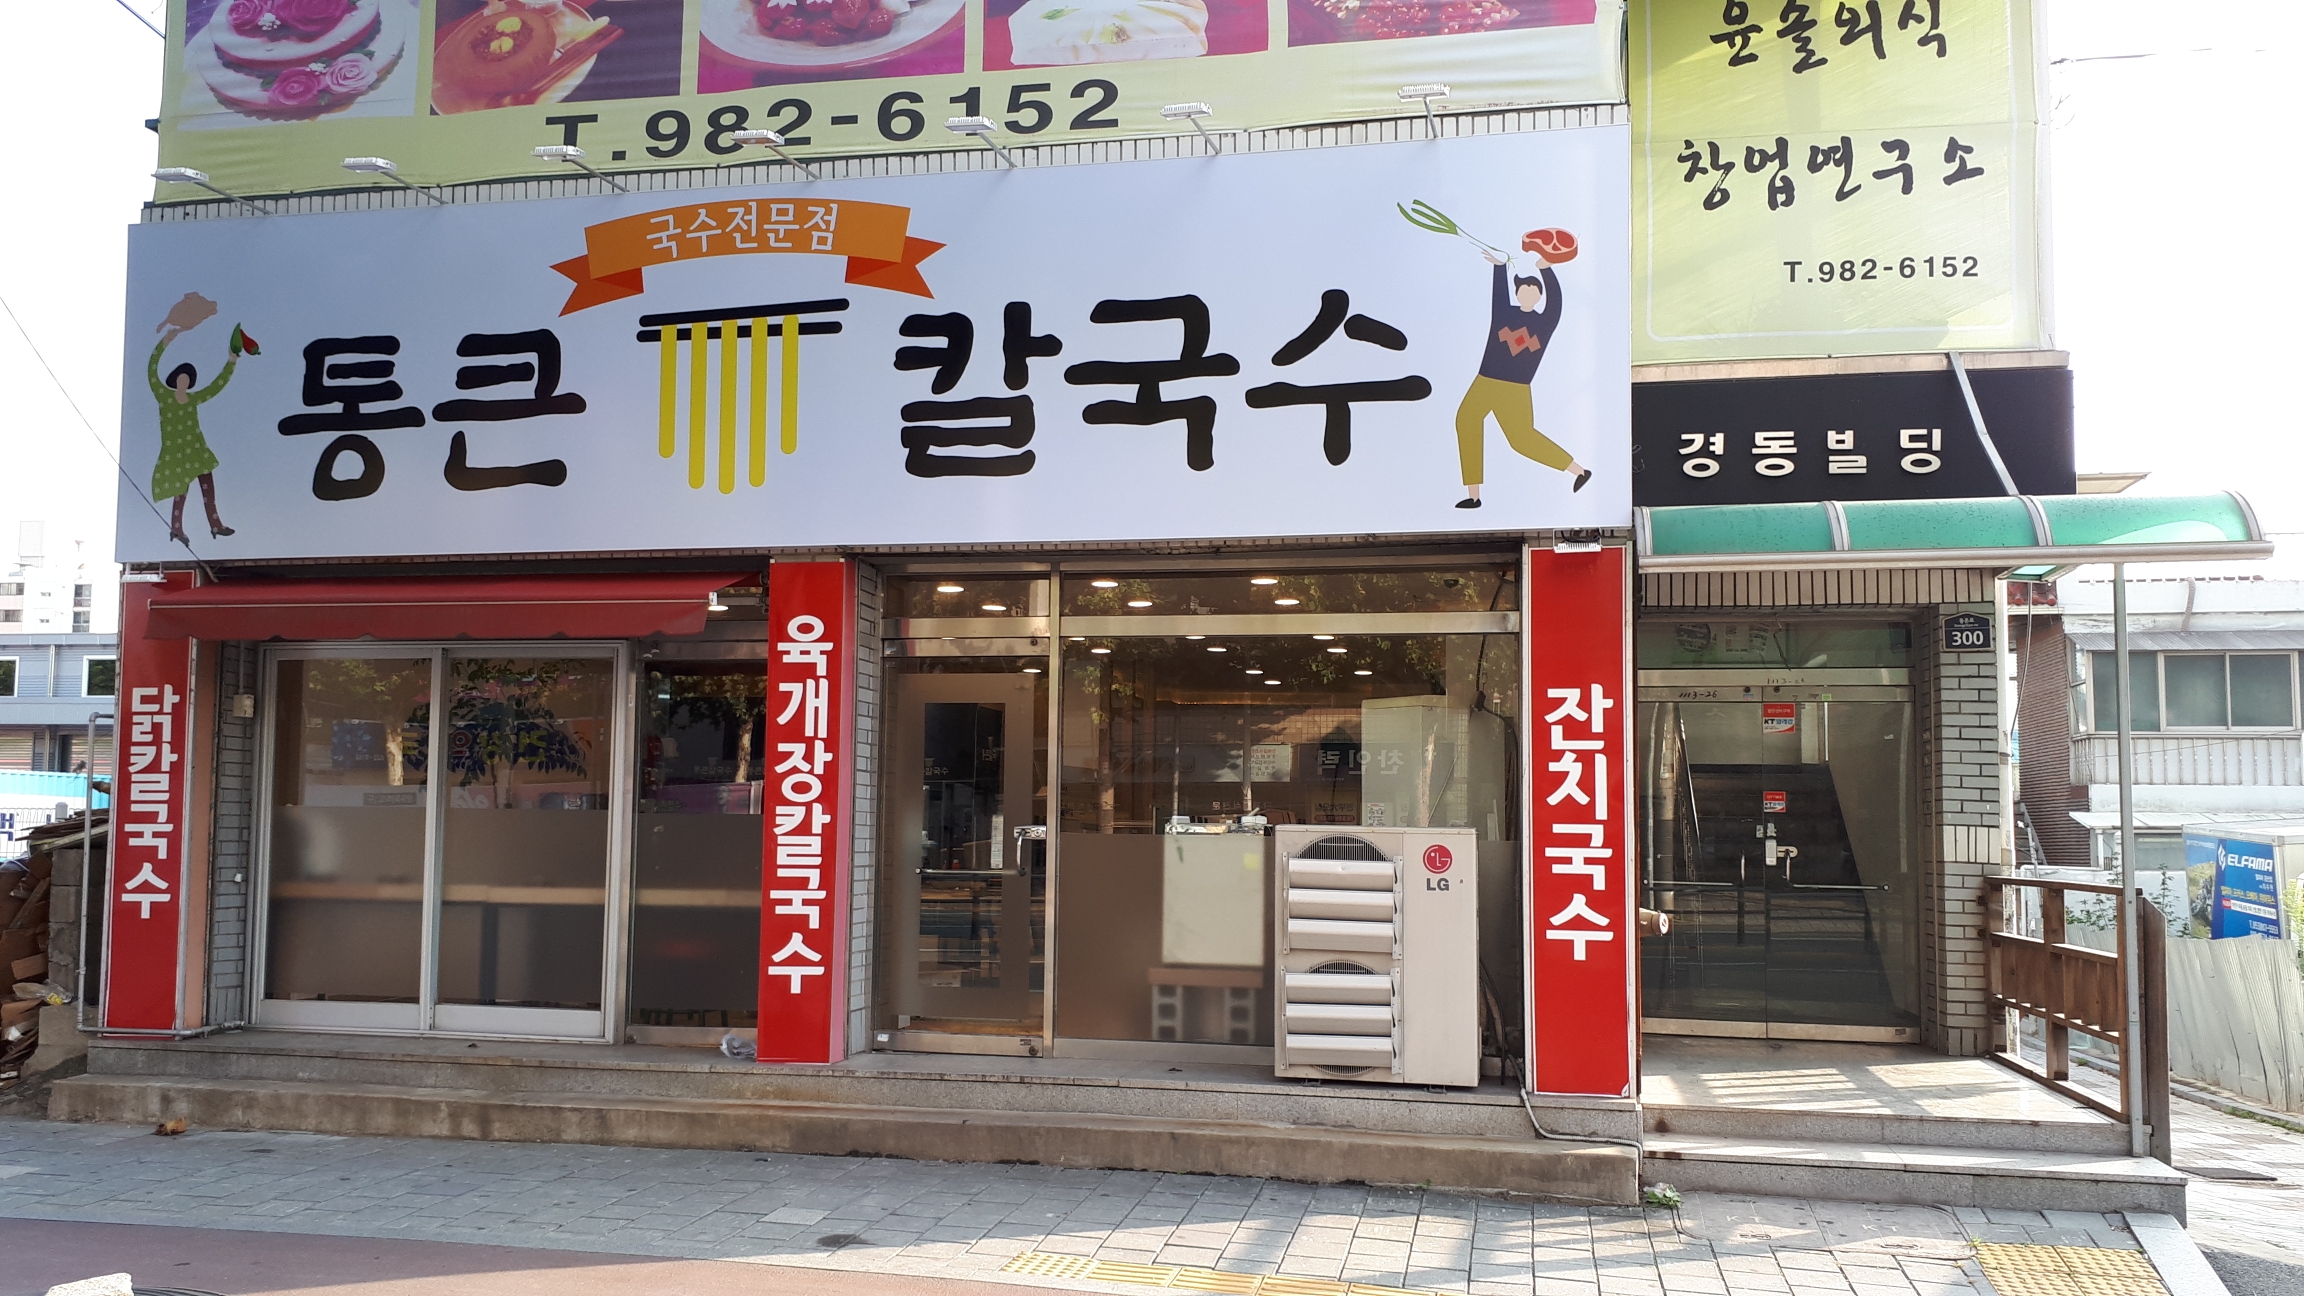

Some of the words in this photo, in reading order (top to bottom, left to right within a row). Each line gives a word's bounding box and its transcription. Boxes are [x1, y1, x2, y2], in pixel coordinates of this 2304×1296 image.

[545, 79, 1119, 162] T.982-6152
[1677, 135, 1985, 211] 창업연구소
[646, 201, 839, 259] 국수전문점
[1783, 256, 1979, 283] T.982-6152
[278, 328, 587, 501] 통큰
[893, 289, 1432, 478] 칼국수
[1678, 428, 1942, 478] 경동빌딩
[1951, 630, 1984, 646] 300
[121, 683, 181, 919] 닭칼국수
[767, 614, 834, 995] 육개장칼국수
[1544, 683, 1614, 962] 잔치국수
[1426, 877, 1450, 891] LG
[2227, 853, 2273, 872] ELFAMA
